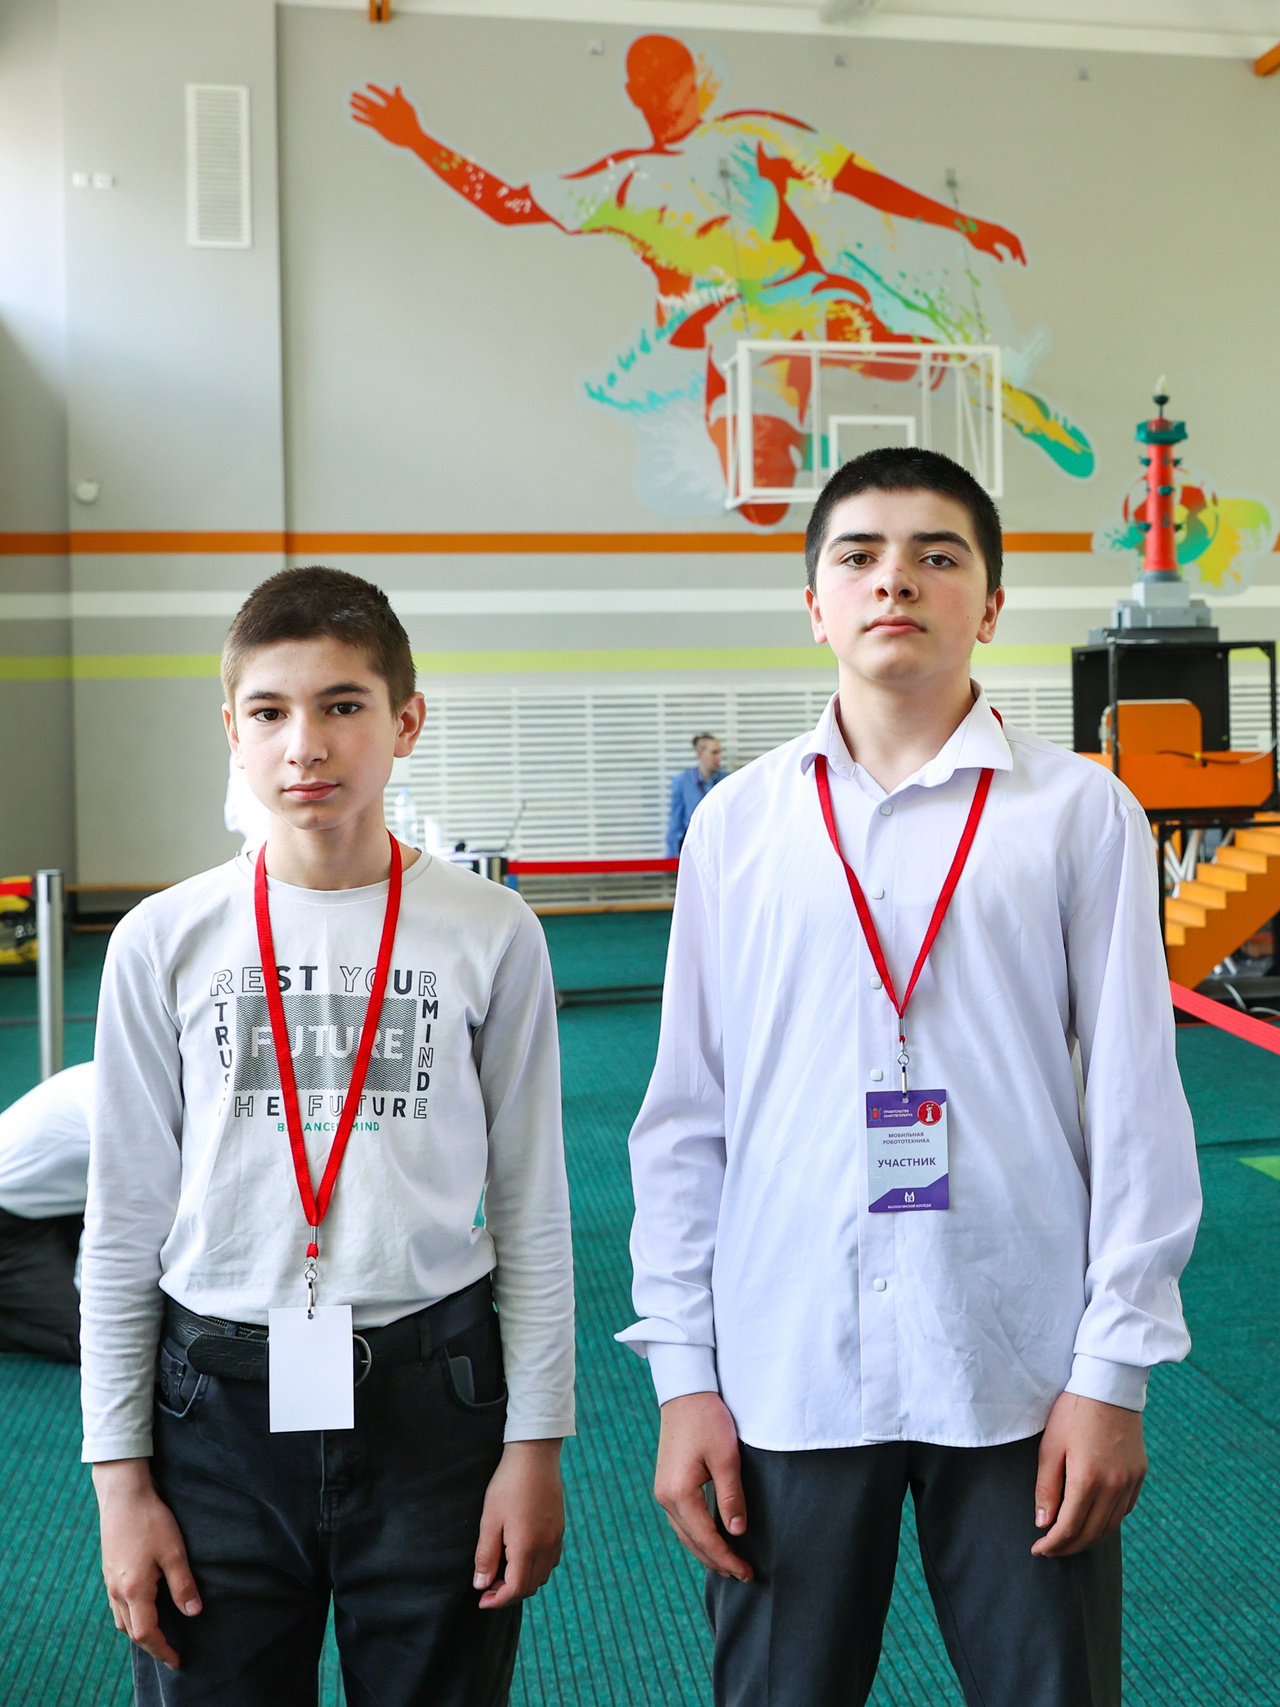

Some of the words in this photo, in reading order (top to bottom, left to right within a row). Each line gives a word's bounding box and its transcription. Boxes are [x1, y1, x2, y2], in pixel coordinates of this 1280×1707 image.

[210, 965, 319, 997] REST
[416, 998, 439, 1092] MIND
[218, 1095, 281, 1118] HE
[878, 1157, 936, 1168] УЧАСТНИК
